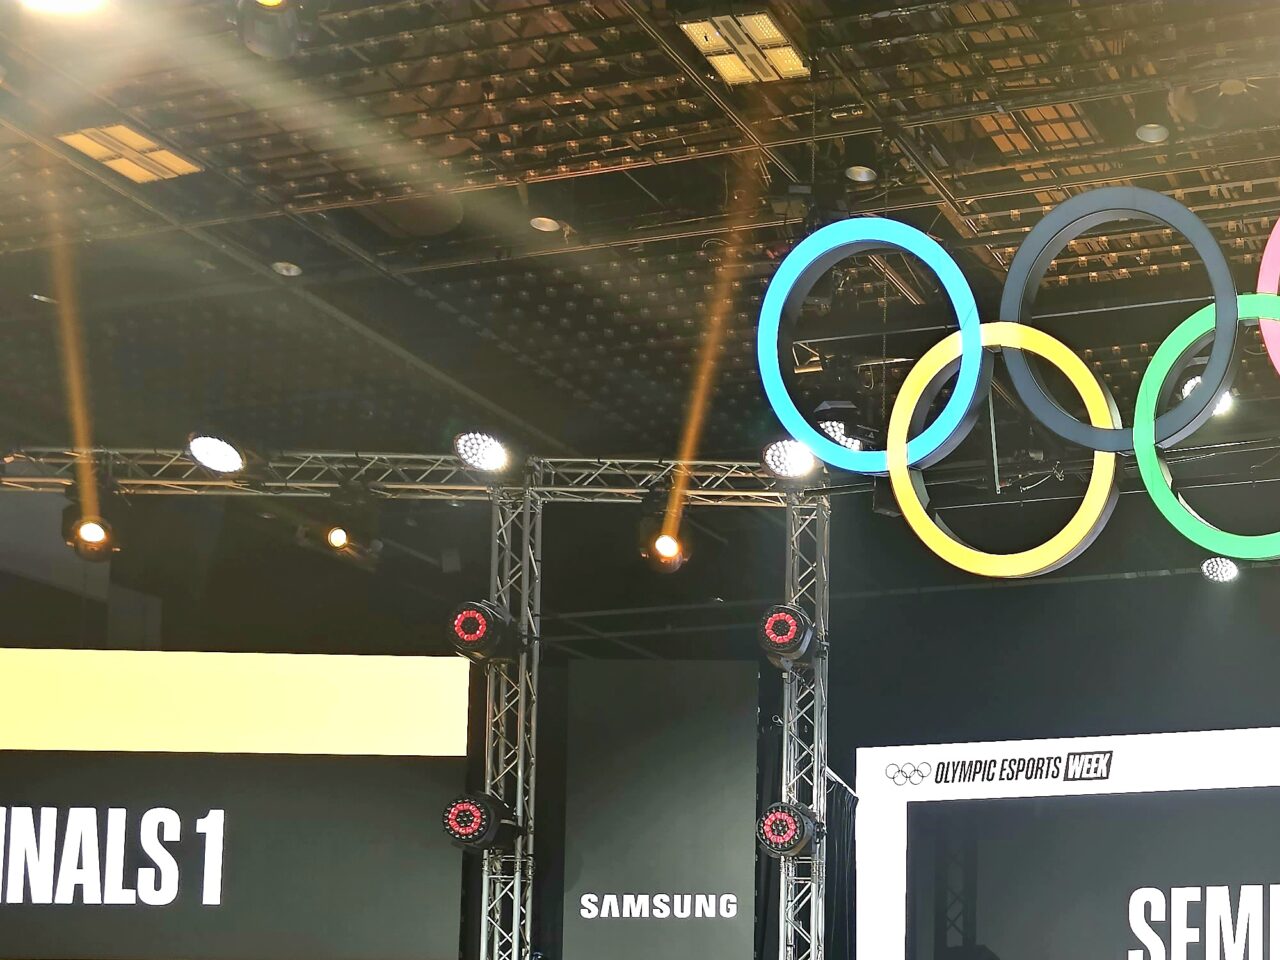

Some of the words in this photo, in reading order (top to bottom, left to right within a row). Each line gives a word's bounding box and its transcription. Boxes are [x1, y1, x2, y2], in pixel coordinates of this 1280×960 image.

[935, 761, 997, 784] OLYMPIC
[999, 756, 1061, 781] ESPORTS
[1067, 752, 1111, 780] WEEK
[0, 806, 181, 906] NALS
[195, 809, 225, 905] 1
[580, 893, 738, 919] SAMSUNG
